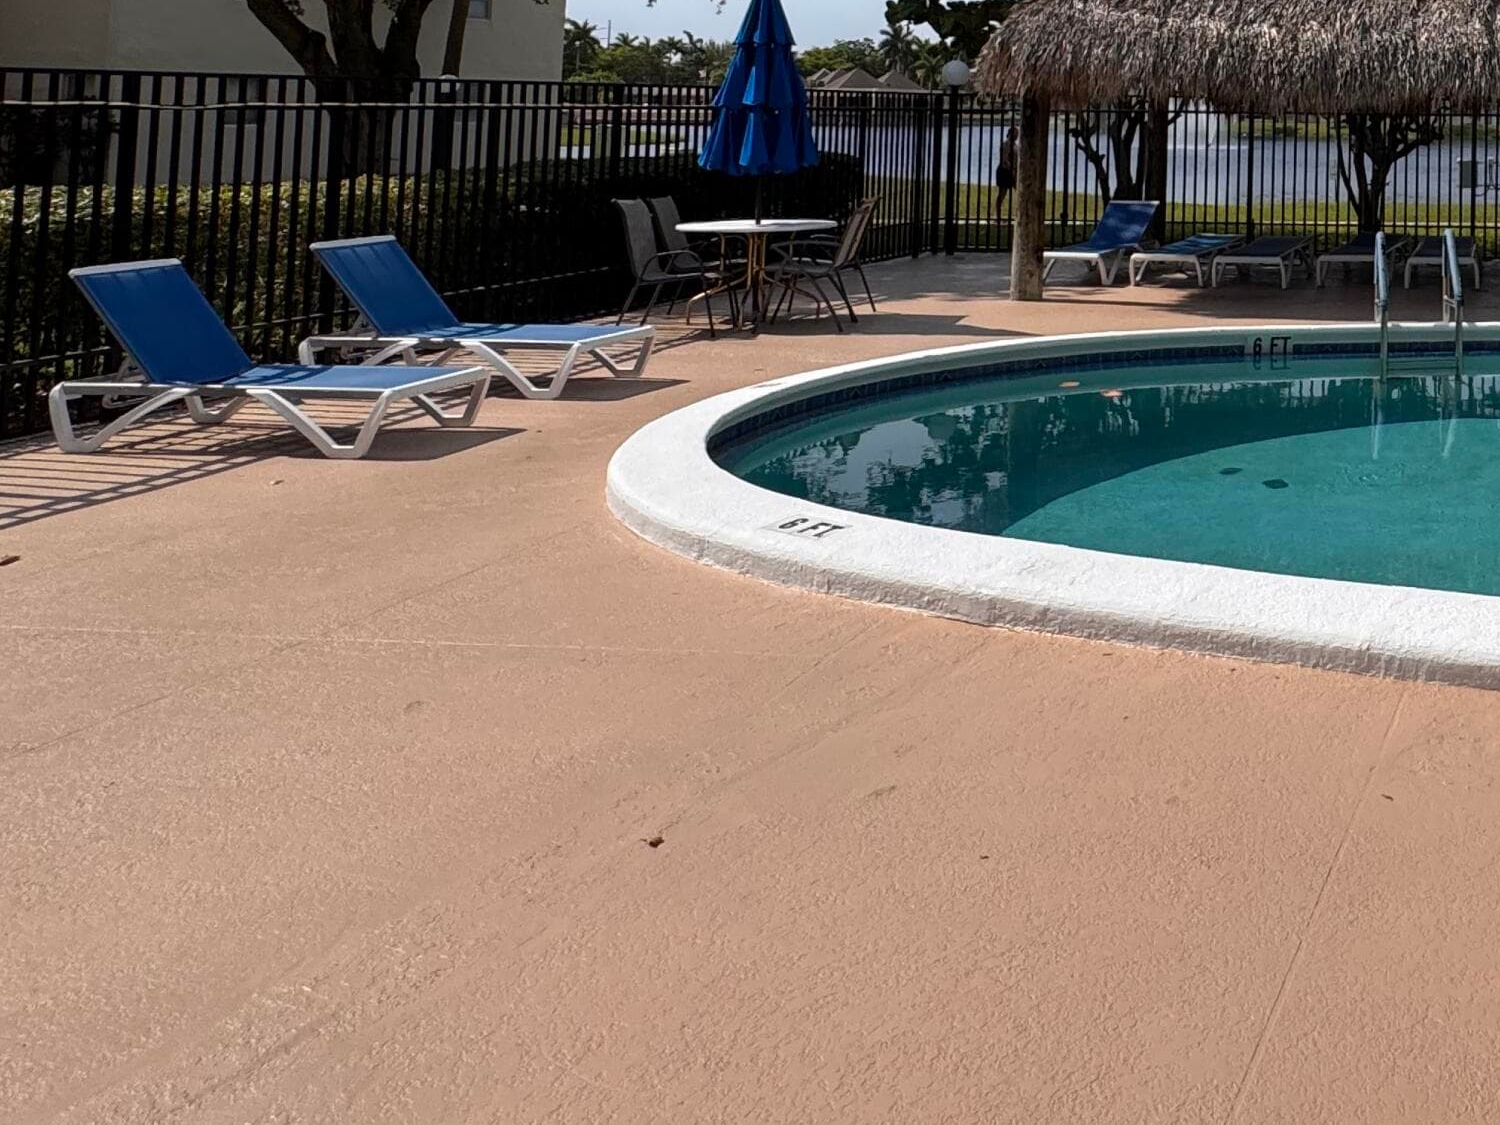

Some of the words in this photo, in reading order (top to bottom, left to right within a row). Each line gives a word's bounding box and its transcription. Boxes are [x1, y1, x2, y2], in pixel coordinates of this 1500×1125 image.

[1253, 337, 1262, 355] 6
[1270, 336, 1291, 355] FT
[779, 518, 809, 529] 6
